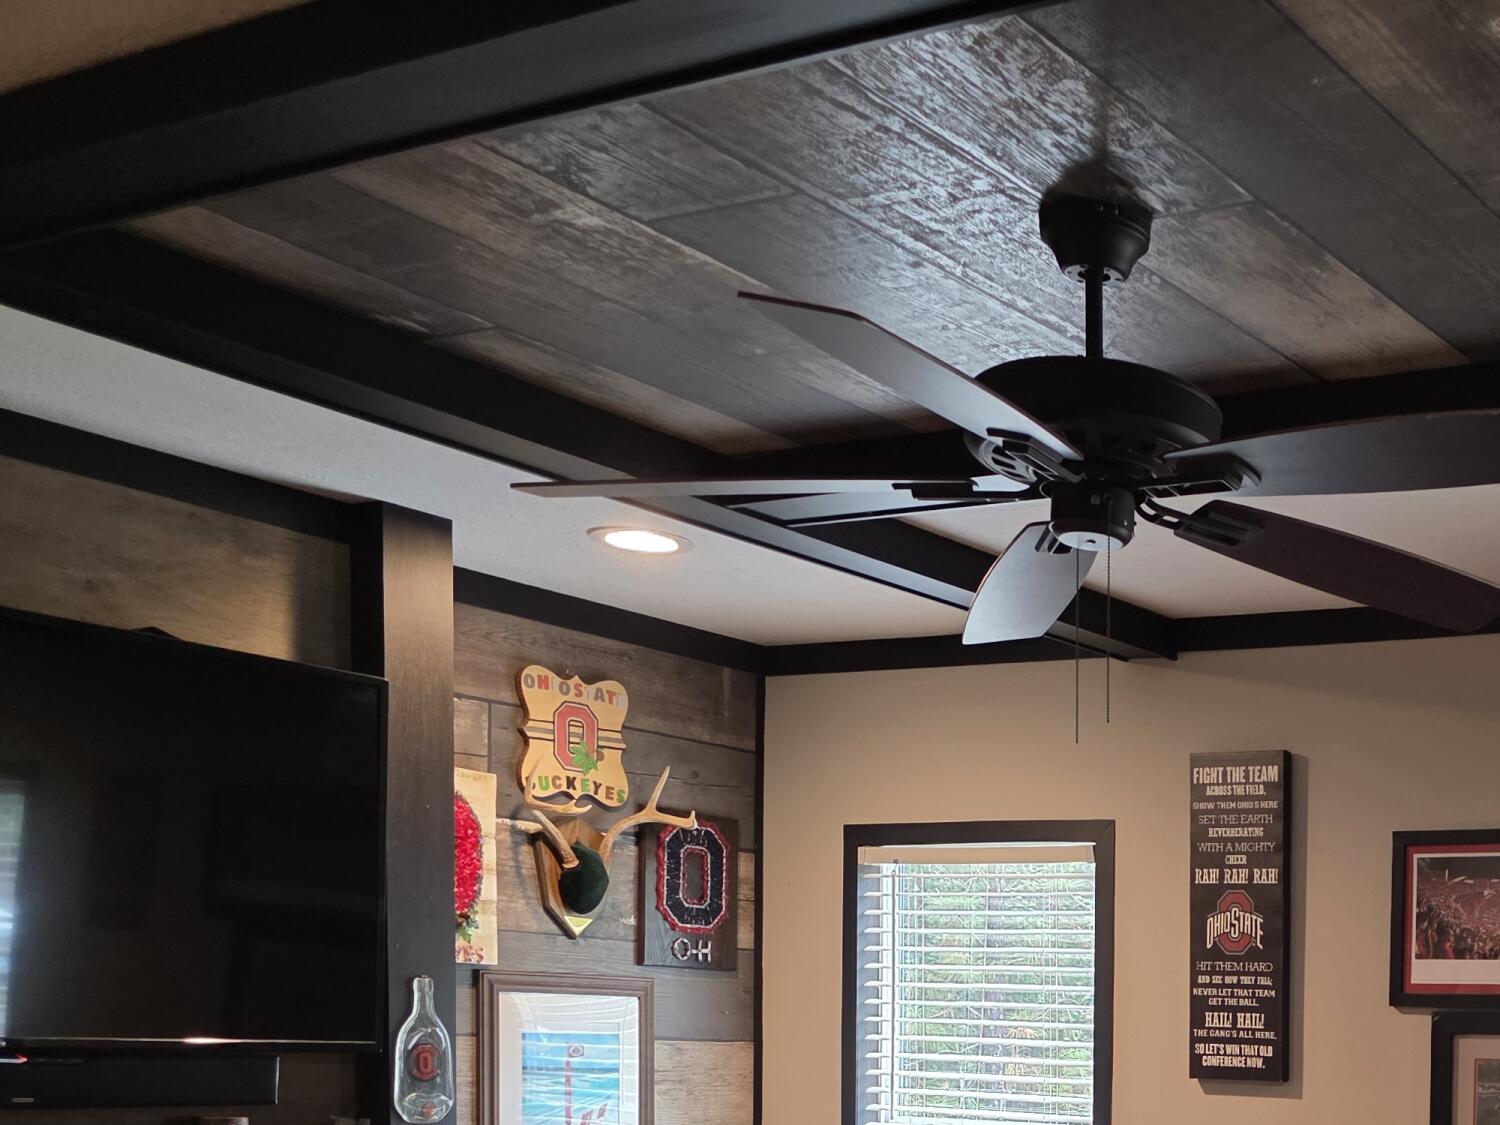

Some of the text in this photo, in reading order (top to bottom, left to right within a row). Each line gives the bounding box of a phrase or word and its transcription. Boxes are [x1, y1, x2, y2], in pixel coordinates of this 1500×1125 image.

[1193, 765, 1279, 784] FIGHT THE TEAM
[525, 775, 626, 803] UCKEYES
[1206, 785, 1232, 796] ACROSS
[1232, 784, 1245, 795] THE
[1198, 813, 1273, 825] SET THE EARTH
[1208, 827, 1264, 838] REVERBERATING
[1197, 842, 1276, 852] WITH A MIGHTY
[1225, 854, 1247, 864] CHEER
[1194, 868, 1279, 884] RAH! RAH! RAH!
[1196, 961, 1274, 972] HIT THEM HARD
[1197, 975, 1210, 984] AND
[1193, 988, 1276, 998] NEVER LET THAT TEAM
[1208, 998, 1223, 1006] GET
[1224, 998, 1238, 1006] THE
[1205, 1012, 1265, 1029] HAIL! HAIL!
[1193, 1029, 1208, 1037] THE
[1209, 1029, 1237, 1038] GANG'S
[1194, 1043, 1273, 1057] SO LET'S WIN THAT OLD
[1202, 1055, 1246, 1068] CONFERENCE
